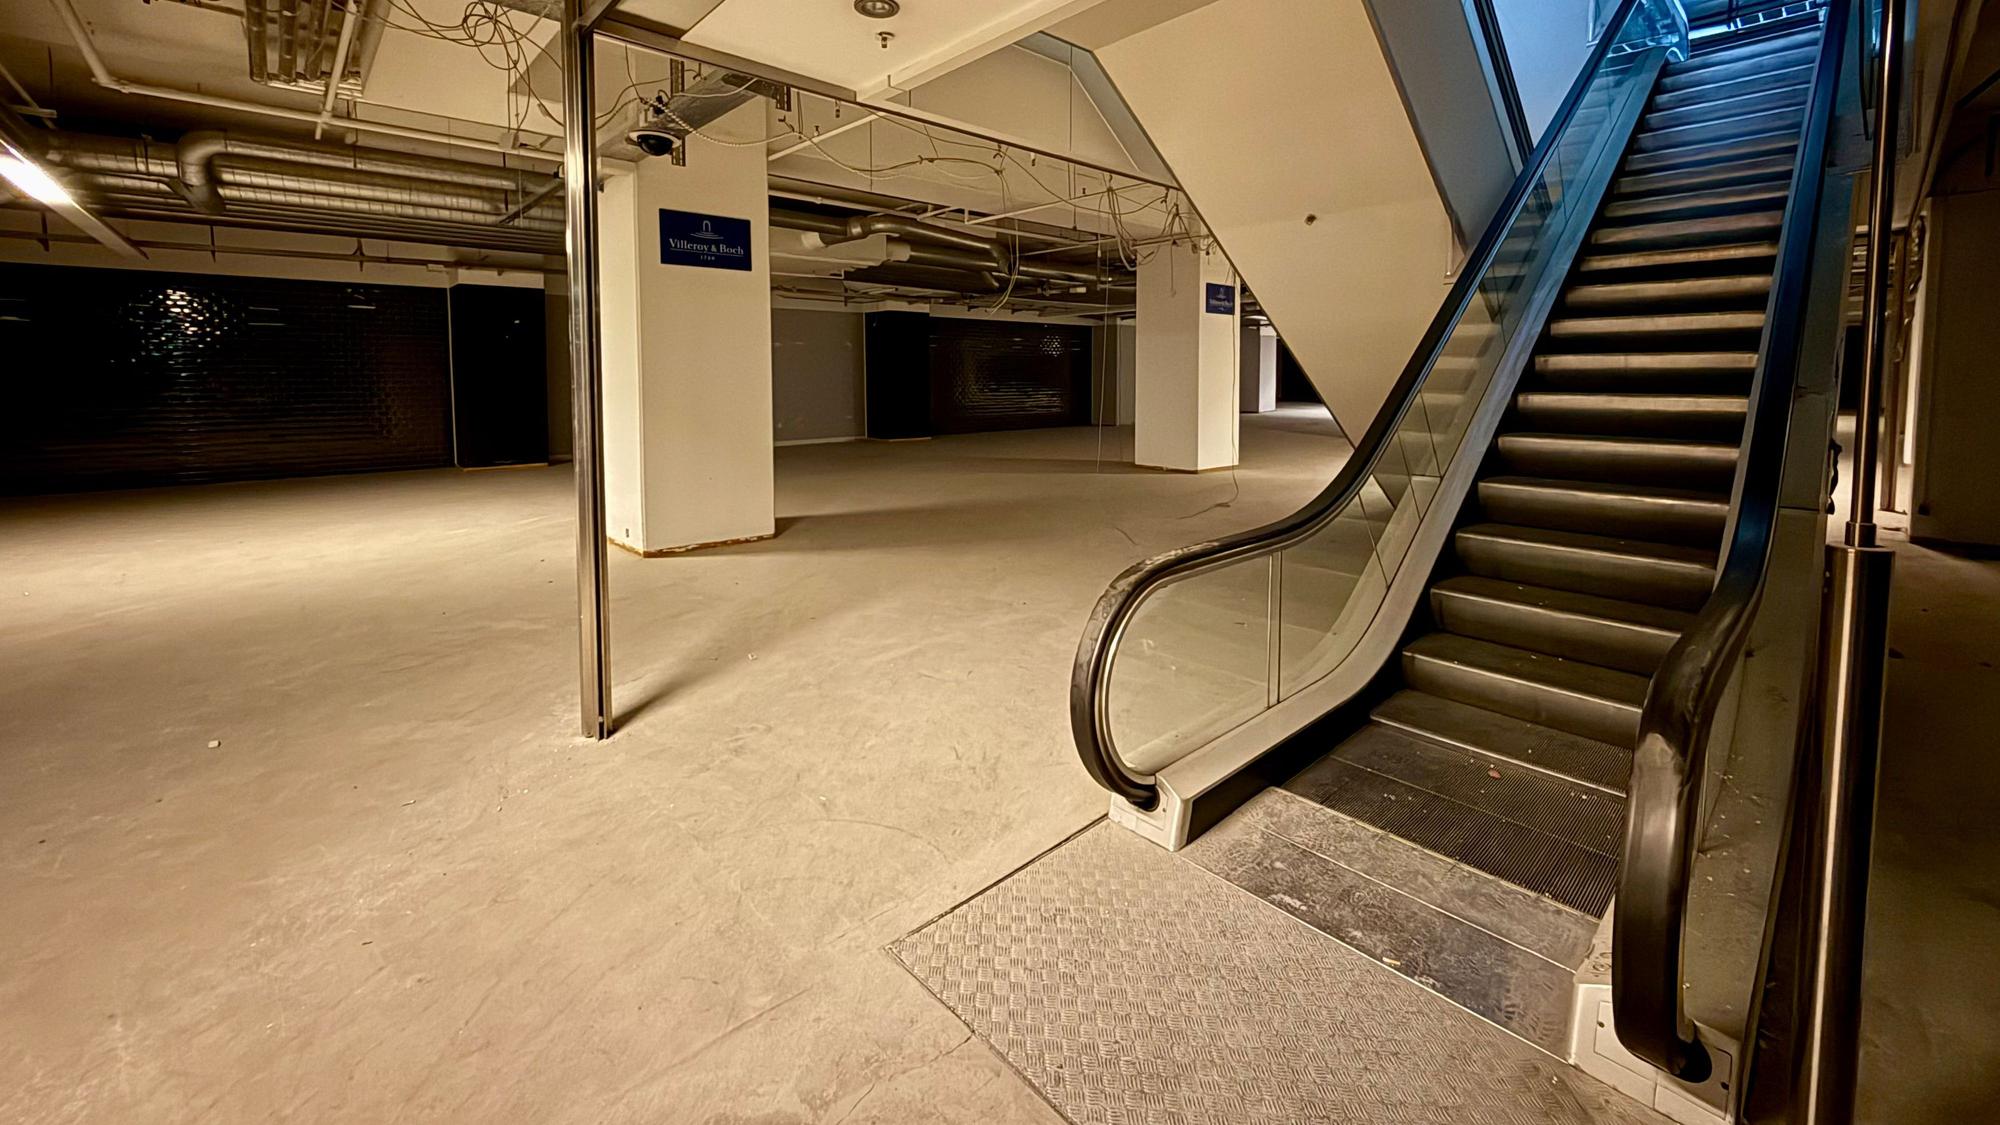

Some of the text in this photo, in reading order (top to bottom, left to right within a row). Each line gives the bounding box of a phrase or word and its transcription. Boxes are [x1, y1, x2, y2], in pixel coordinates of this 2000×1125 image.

[669, 238, 744, 255] Villeroy & Boch
